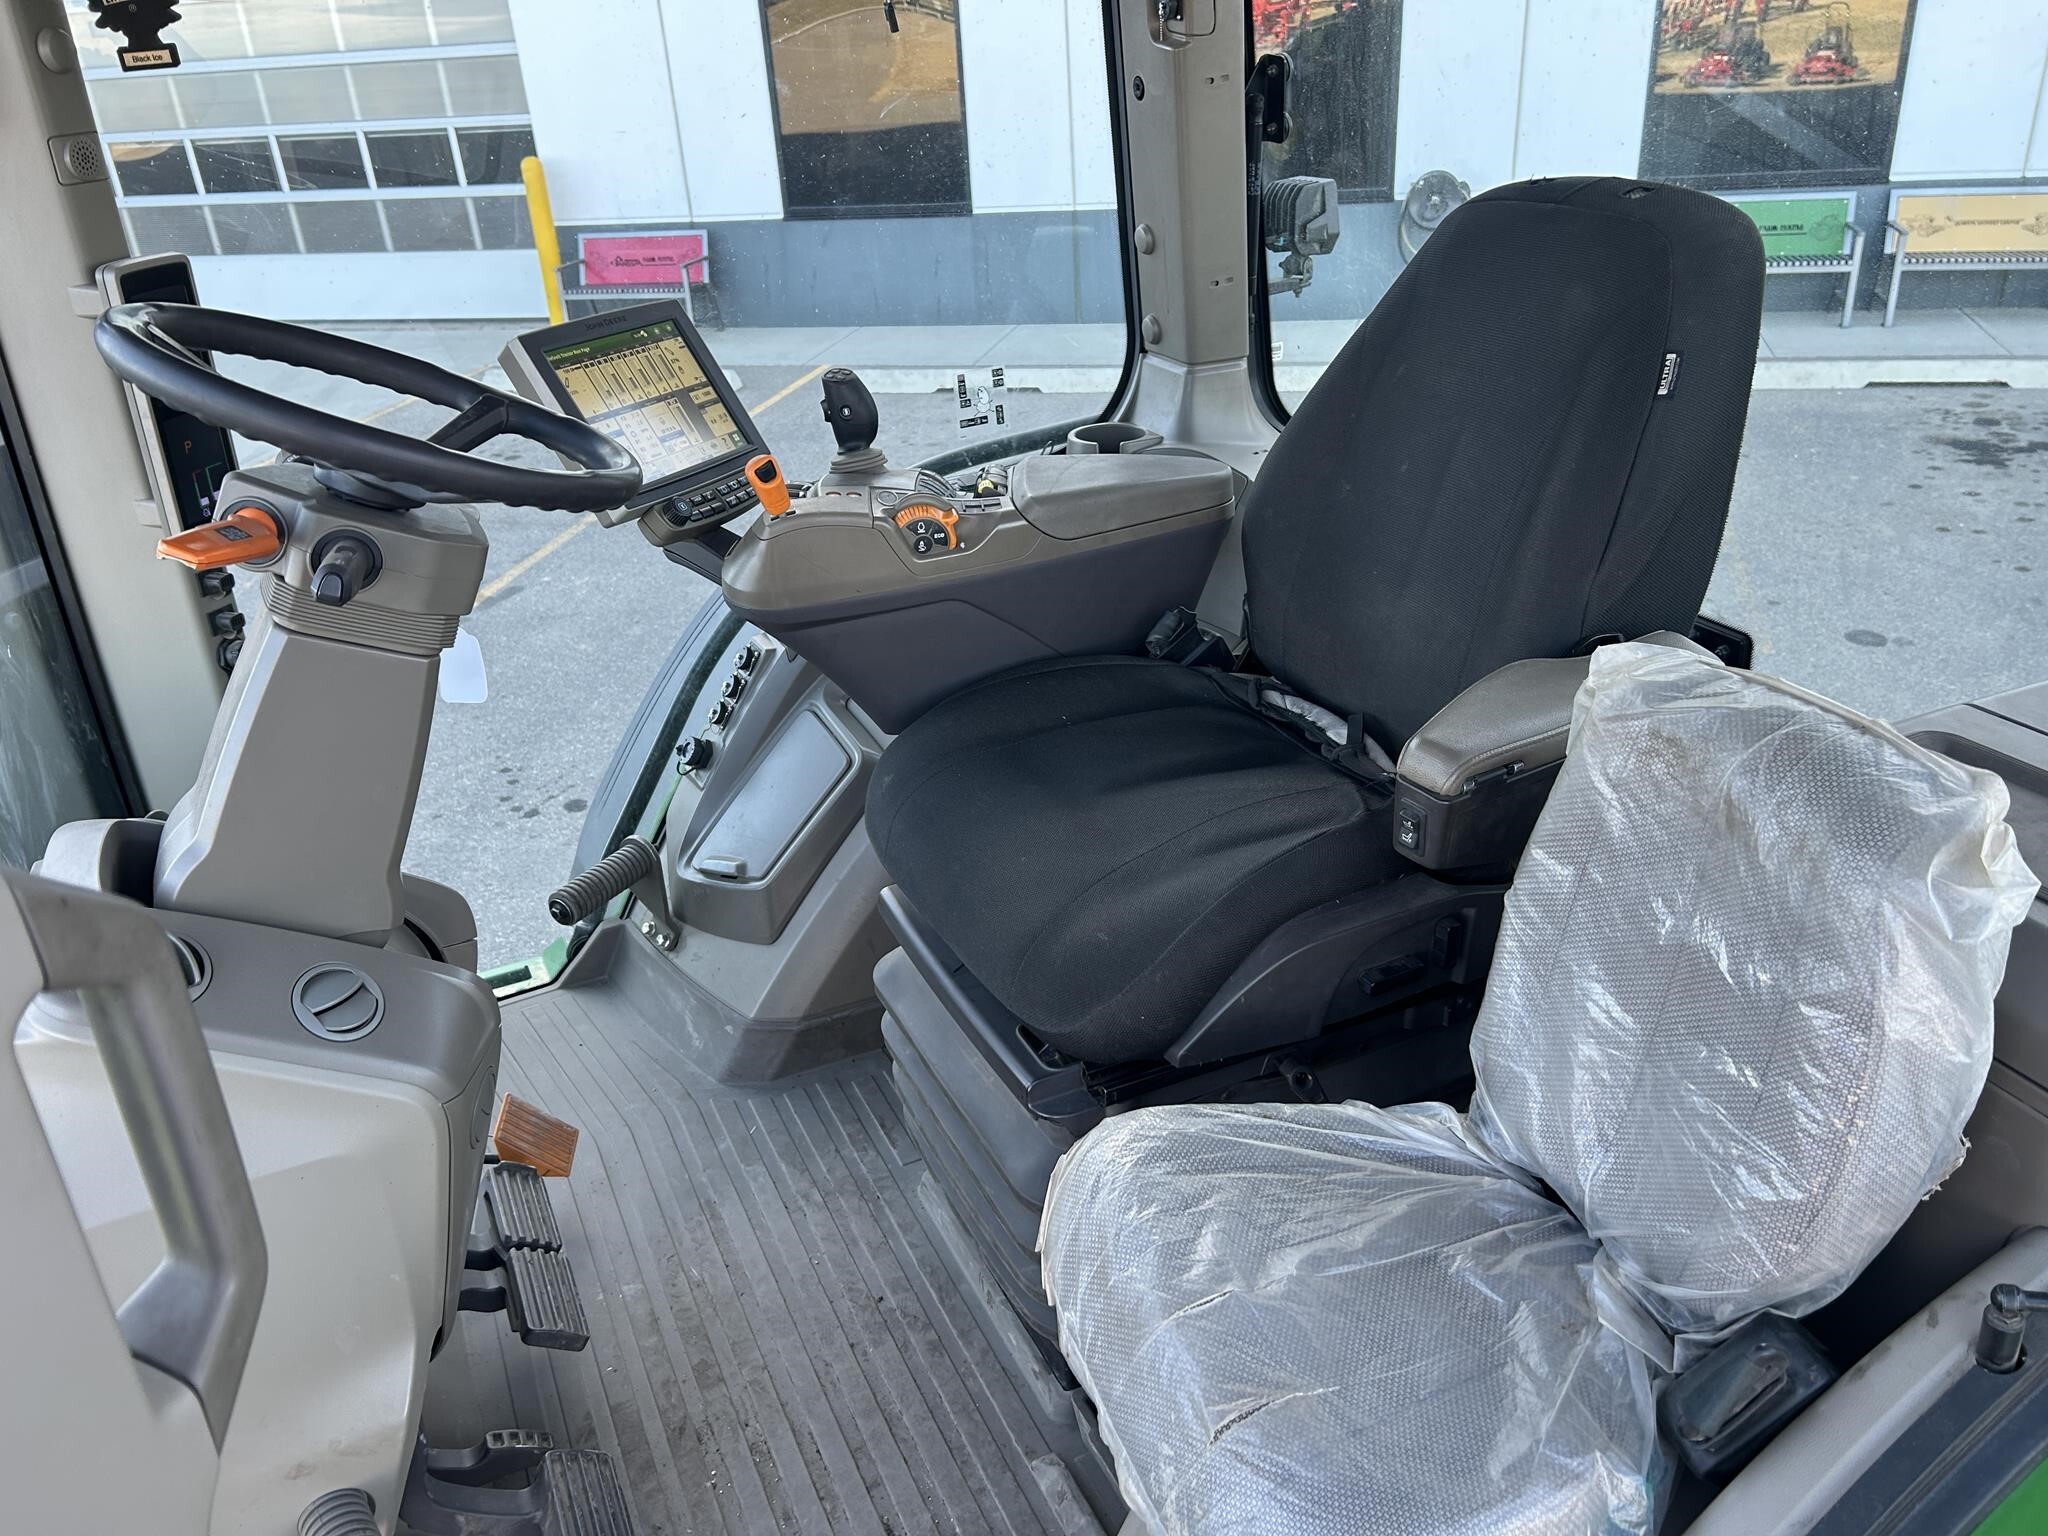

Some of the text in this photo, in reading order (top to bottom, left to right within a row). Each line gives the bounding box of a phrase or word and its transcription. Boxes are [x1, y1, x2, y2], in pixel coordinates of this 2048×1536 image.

[132, 55, 151, 63] Black
[1660, 359, 1671, 389] ULTRA
[184, 440, 192, 455] P
